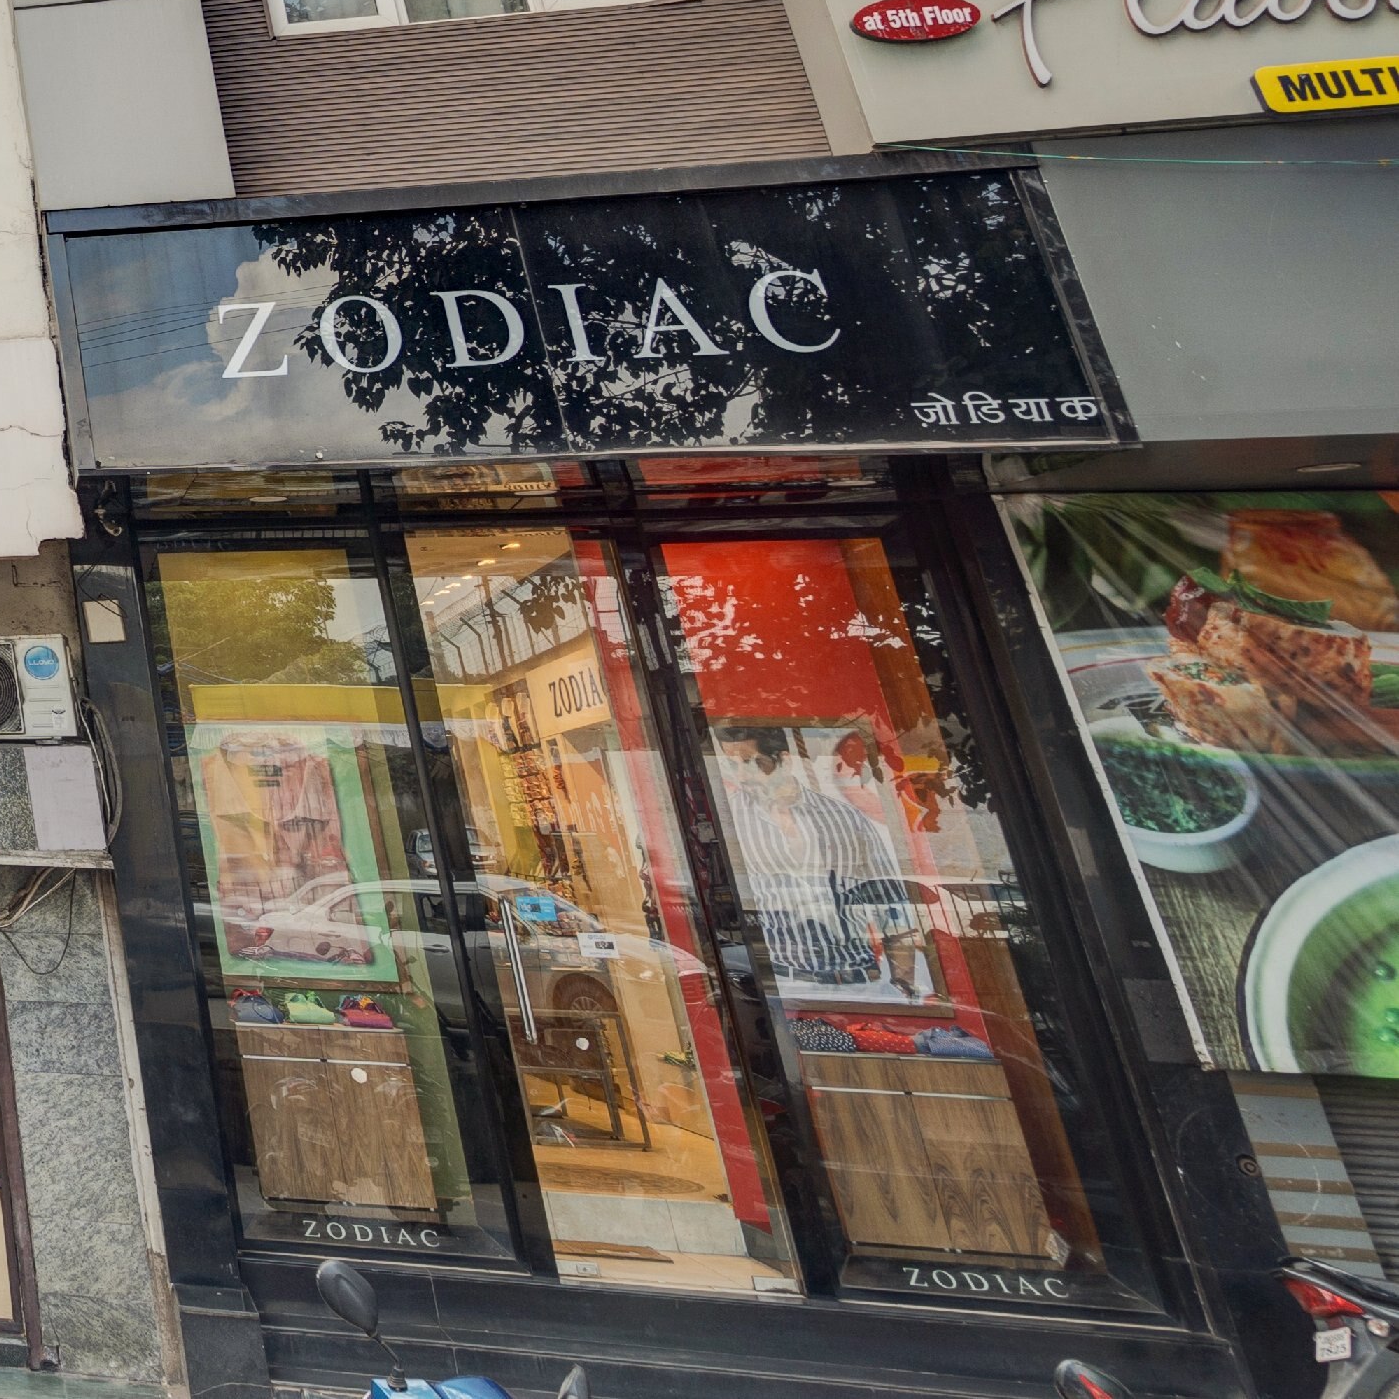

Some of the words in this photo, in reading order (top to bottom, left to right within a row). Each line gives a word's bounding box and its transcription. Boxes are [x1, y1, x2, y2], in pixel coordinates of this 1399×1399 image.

[861, 9, 885, 32] at
[887, 7, 921, 31] 5th
[922, 3, 974, 28] Floor
[217, 269, 841, 380] ZODIAC
[302, 1219, 441, 1248] ZODIAC
[902, 1266, 1070, 1299] ZODIAC
